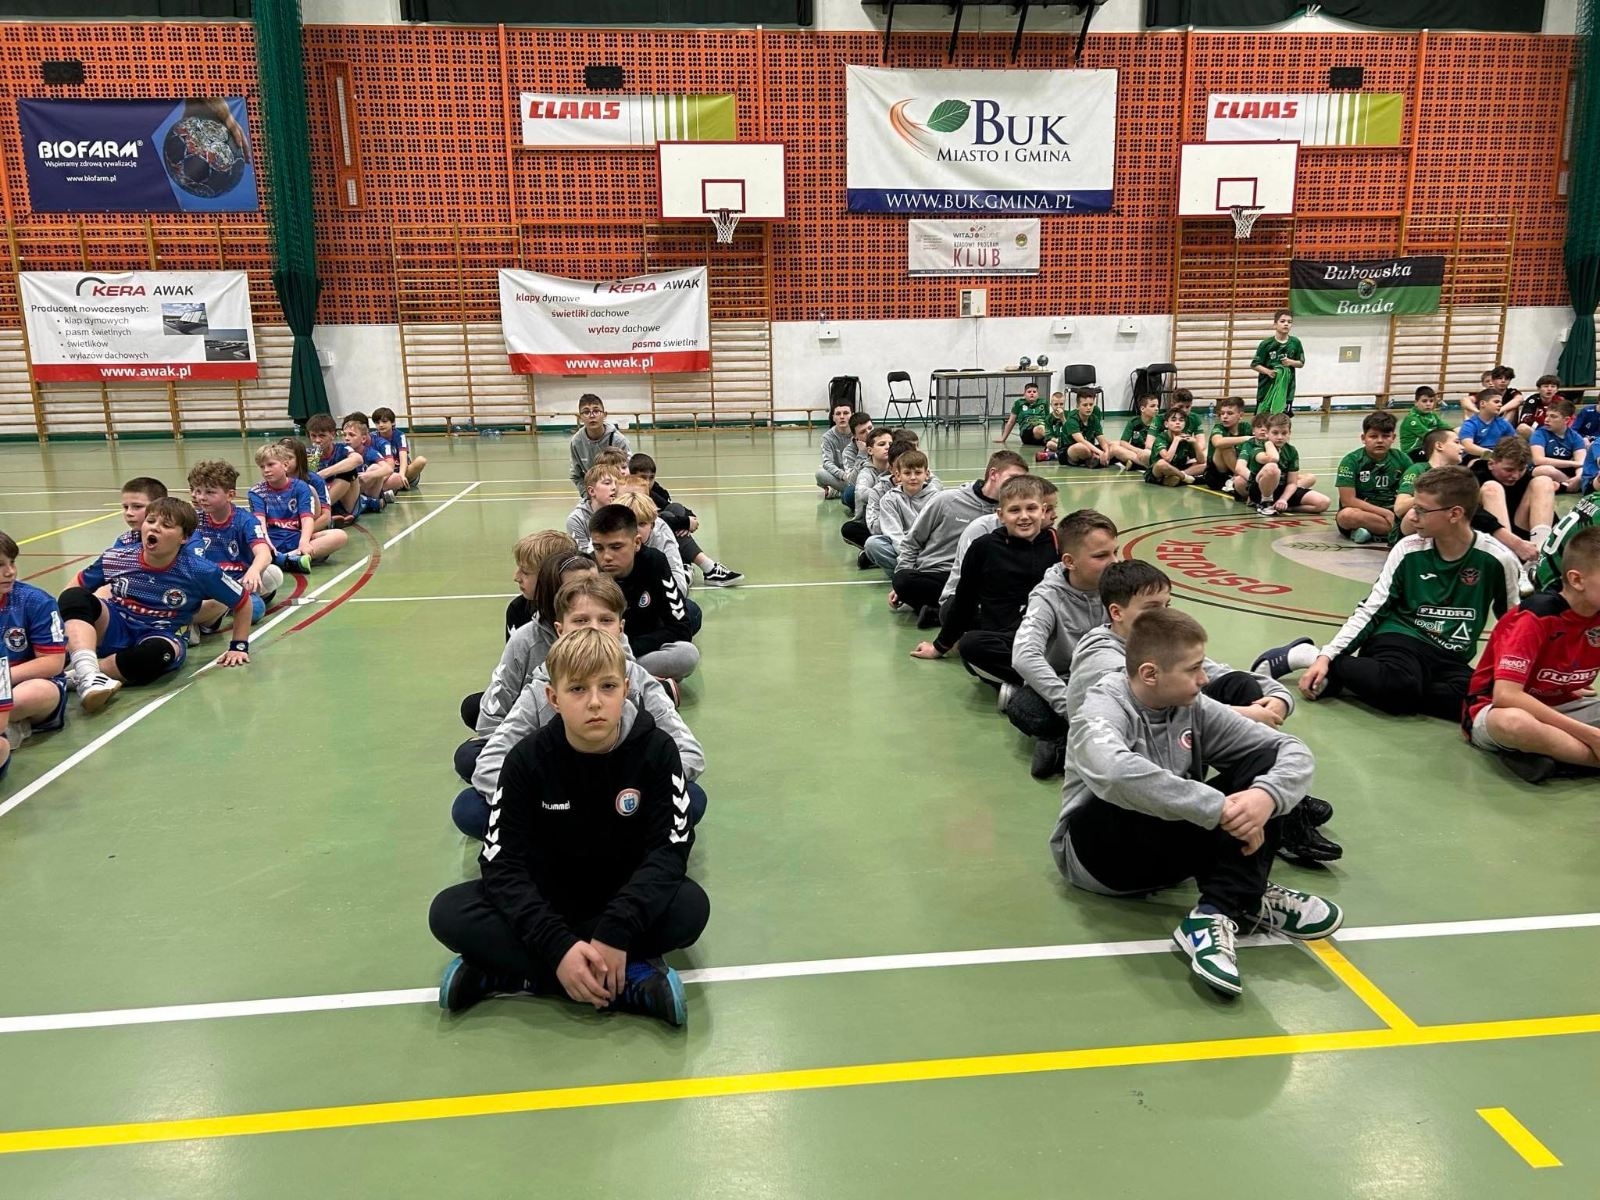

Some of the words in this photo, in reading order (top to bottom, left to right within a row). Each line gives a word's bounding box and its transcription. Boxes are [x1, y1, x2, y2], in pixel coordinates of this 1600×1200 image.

[528, 101, 621, 119] CLAAS
[1214, 101, 1299, 119] CLAAS
[44, 160, 79, 168] Wspieramy
[66, 175, 117, 183] www.biofarm.pl
[885, 193, 1075, 210] WWW.BUK.GMINA.PL
[953, 248, 1001, 267] KLUB
[1323, 263, 1412, 281] Bukowska
[92, 285, 146, 297] KERA
[153, 285, 194, 296] AWAK
[608, 282, 657, 294] KERA
[663, 278, 700, 290] AWAK
[516, 293, 540, 303] klapy
[541, 293, 581, 303] dymowe
[31, 304, 77, 313] Producent
[79, 305, 149, 313] nowoczesnych:
[1336, 299, 1394, 314] Banda
[551, 309, 589, 318] świetliki
[590, 309, 630, 318] dachowe
[64, 316, 82, 325] klap
[84, 315, 129, 325] dymowych
[65, 329, 89, 338] pasm
[91, 327, 132, 336] świetlnych
[588, 326, 620, 335] wyłazy
[622, 325, 661, 333] dachowe
[632, 341, 661, 350] pasma
[663, 338, 698, 348] świetlne
[69, 352, 103, 360] wyłazów
[104, 351, 149, 359] dachowych
[566, 357, 654, 370] www.awak.pl
[100, 366, 192, 379] www.awak.pl
[1553, 446, 1566, 456] 32
[1375, 475, 1389, 487] 20
[1543, 511, 1580, 555] 9
[1156, 539, 1292, 595] OŚRODEK
[1420, 607, 1473, 618] FLUDRA
[542, 801, 570, 811] hummel
